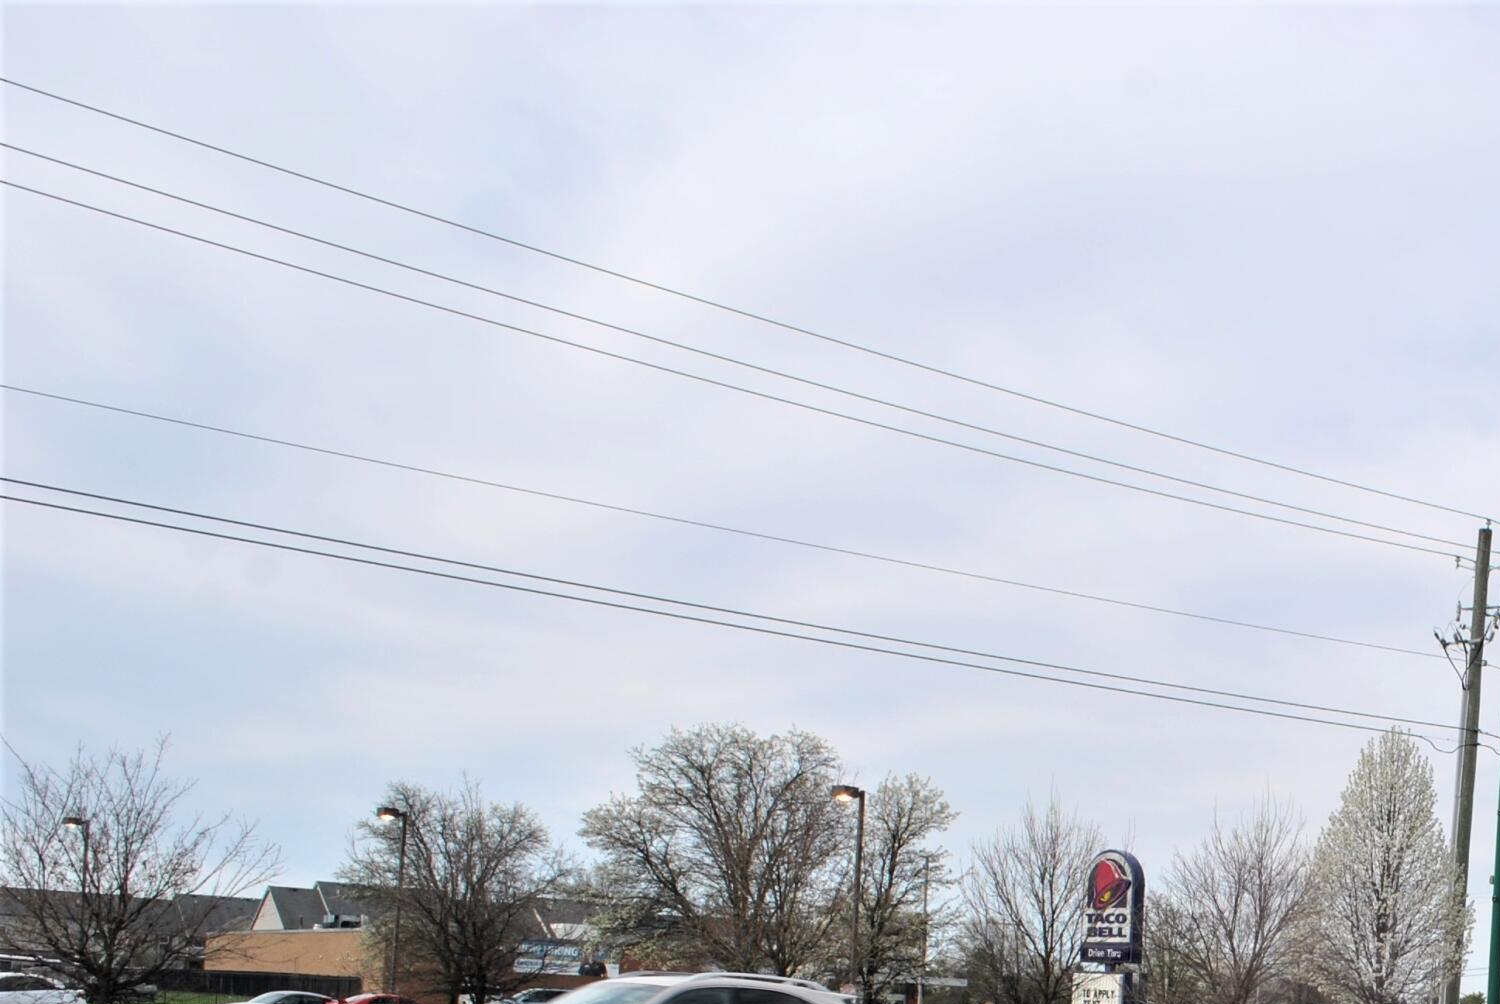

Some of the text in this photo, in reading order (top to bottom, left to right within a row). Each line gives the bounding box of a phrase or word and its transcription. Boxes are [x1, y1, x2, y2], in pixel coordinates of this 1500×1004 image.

[1085, 913, 1127, 924] TACO
[1087, 927, 1127, 937] BELL
[1088, 948, 1121, 958] Drive Thru
[1083, 989, 1114, 999] TO APPLY
